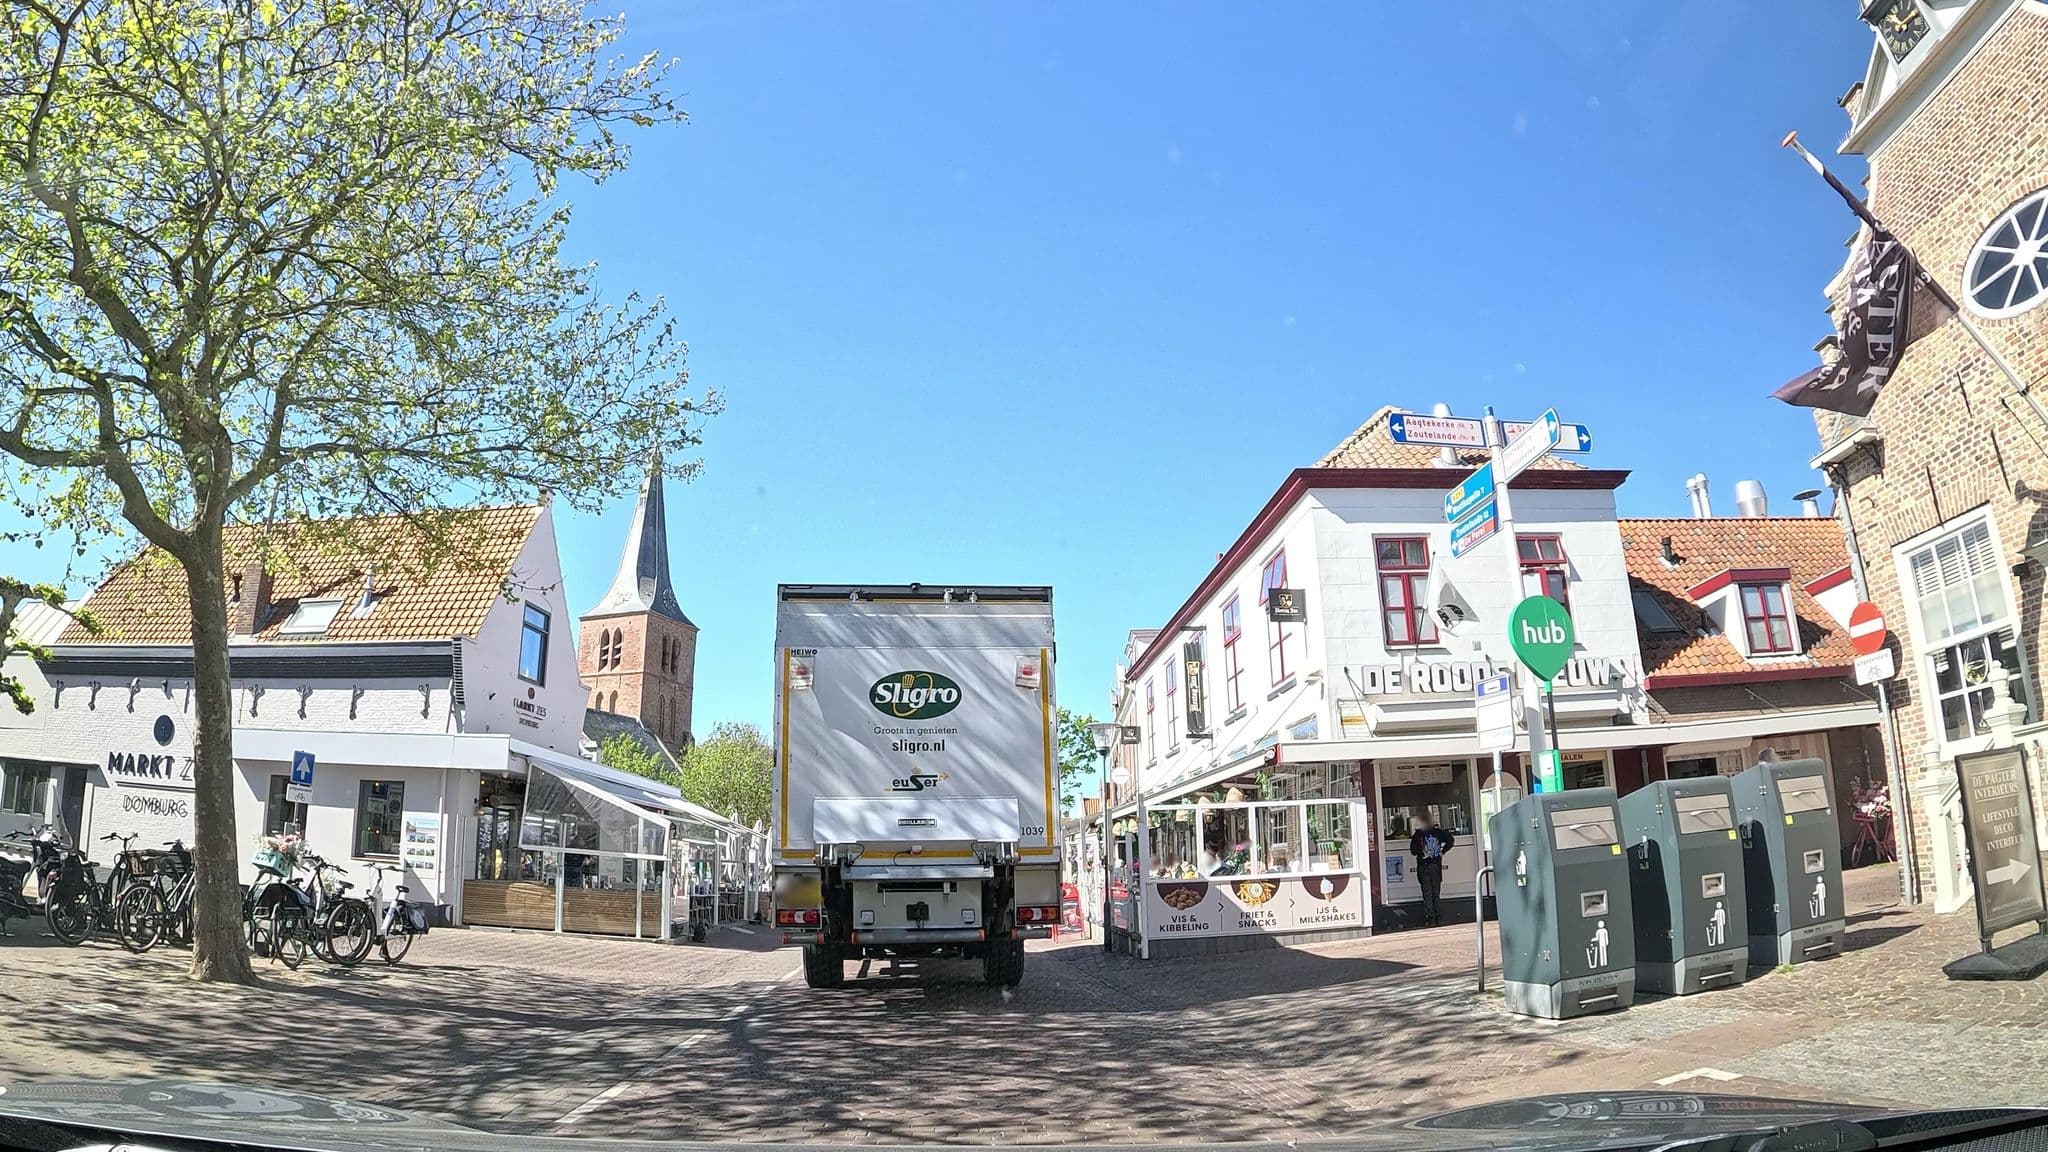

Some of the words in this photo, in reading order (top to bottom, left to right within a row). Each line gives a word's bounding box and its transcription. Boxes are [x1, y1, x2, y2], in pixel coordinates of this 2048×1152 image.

[1405, 417, 1455, 429] Aagtekerke
[1407, 430, 1457, 440] Zoutelande
[1522, 618, 1566, 644] hub
[1361, 664, 1403, 695] DE
[1409, 660, 1509, 694] ROOD
[875, 682, 958, 709] Sligro
[873, 726, 904, 735] Groots
[906, 727, 915, 735] in
[916, 727, 958, 736] genieten
[892, 739, 945, 754] sligro.nl
[107, 751, 175, 779] MARKT
[1972, 774, 1984, 788] DE
[1985, 769, 2017, 785] PAGTER
[1974, 784, 2019, 800] INTERIEURS
[123, 795, 188, 817] DOMBURG
[1982, 807, 2020, 823] LIFESTYLE
[1021, 826, 1045, 836] 1039
[1993, 822, 2014, 836] DECO
[1240, 911, 1264, 920] FRIET
[1316, 906, 1330, 915] IJS
[1171, 915, 1187, 923] VIS
[1189, 914, 1197, 922] &
[1238, 918, 1277, 928] SNACKS
[1299, 912, 1357, 924] MILKSHAKES
[1159, 922, 1210, 932] KIBBELING
